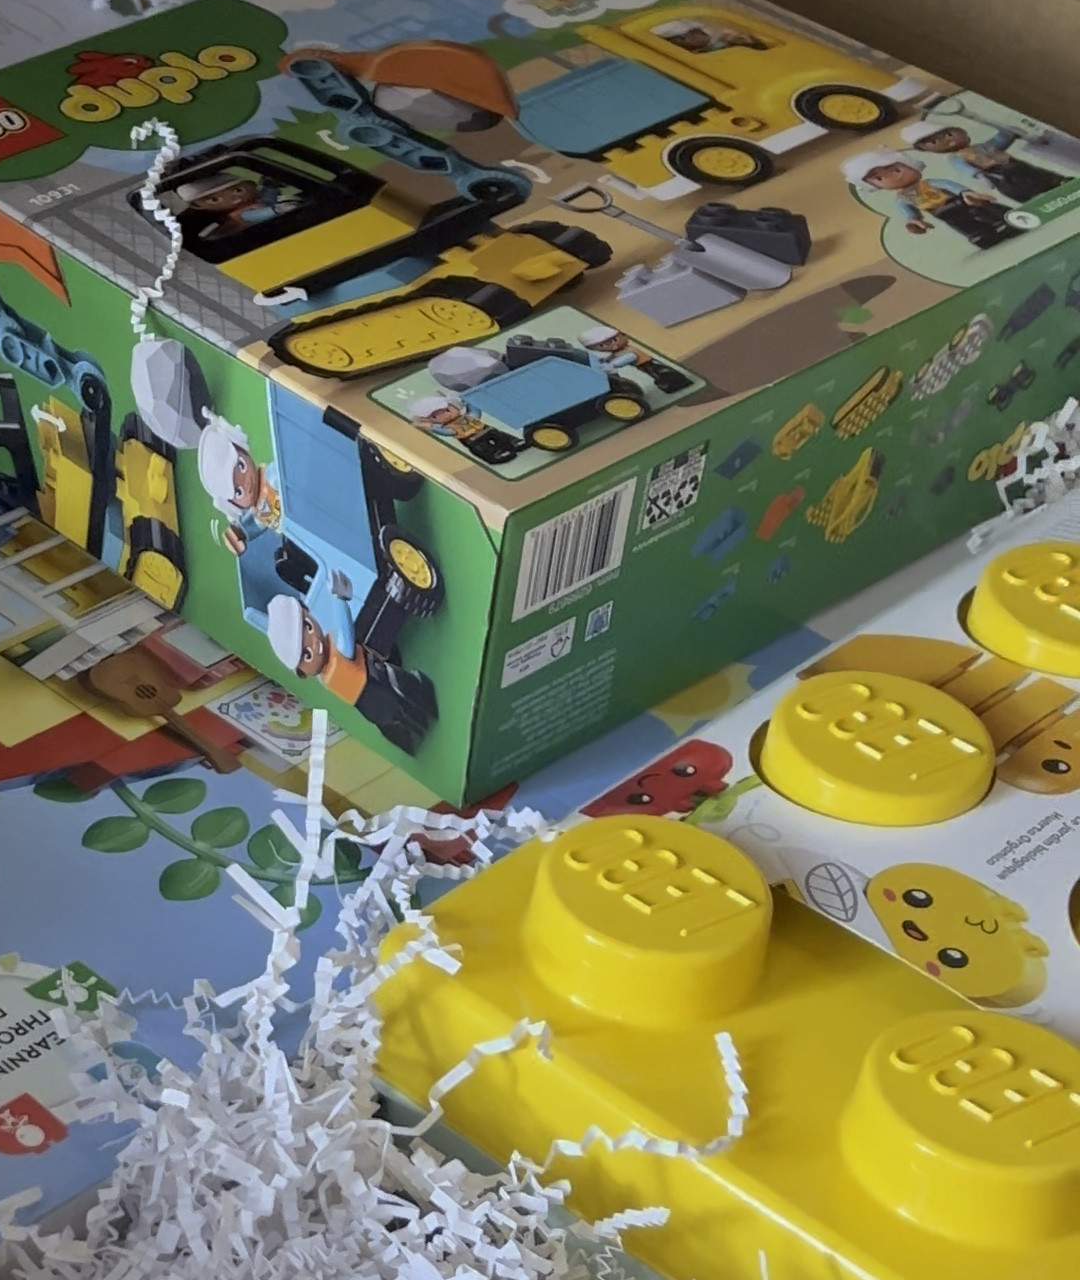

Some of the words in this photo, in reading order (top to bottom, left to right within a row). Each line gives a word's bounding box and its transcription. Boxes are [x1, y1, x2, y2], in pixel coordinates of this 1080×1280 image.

[60, 44, 260, 123] duplo
[30, 182, 81, 206] 10931
[796, 683, 980, 781] LEGO
[564, 829, 757, 937] LEGO
